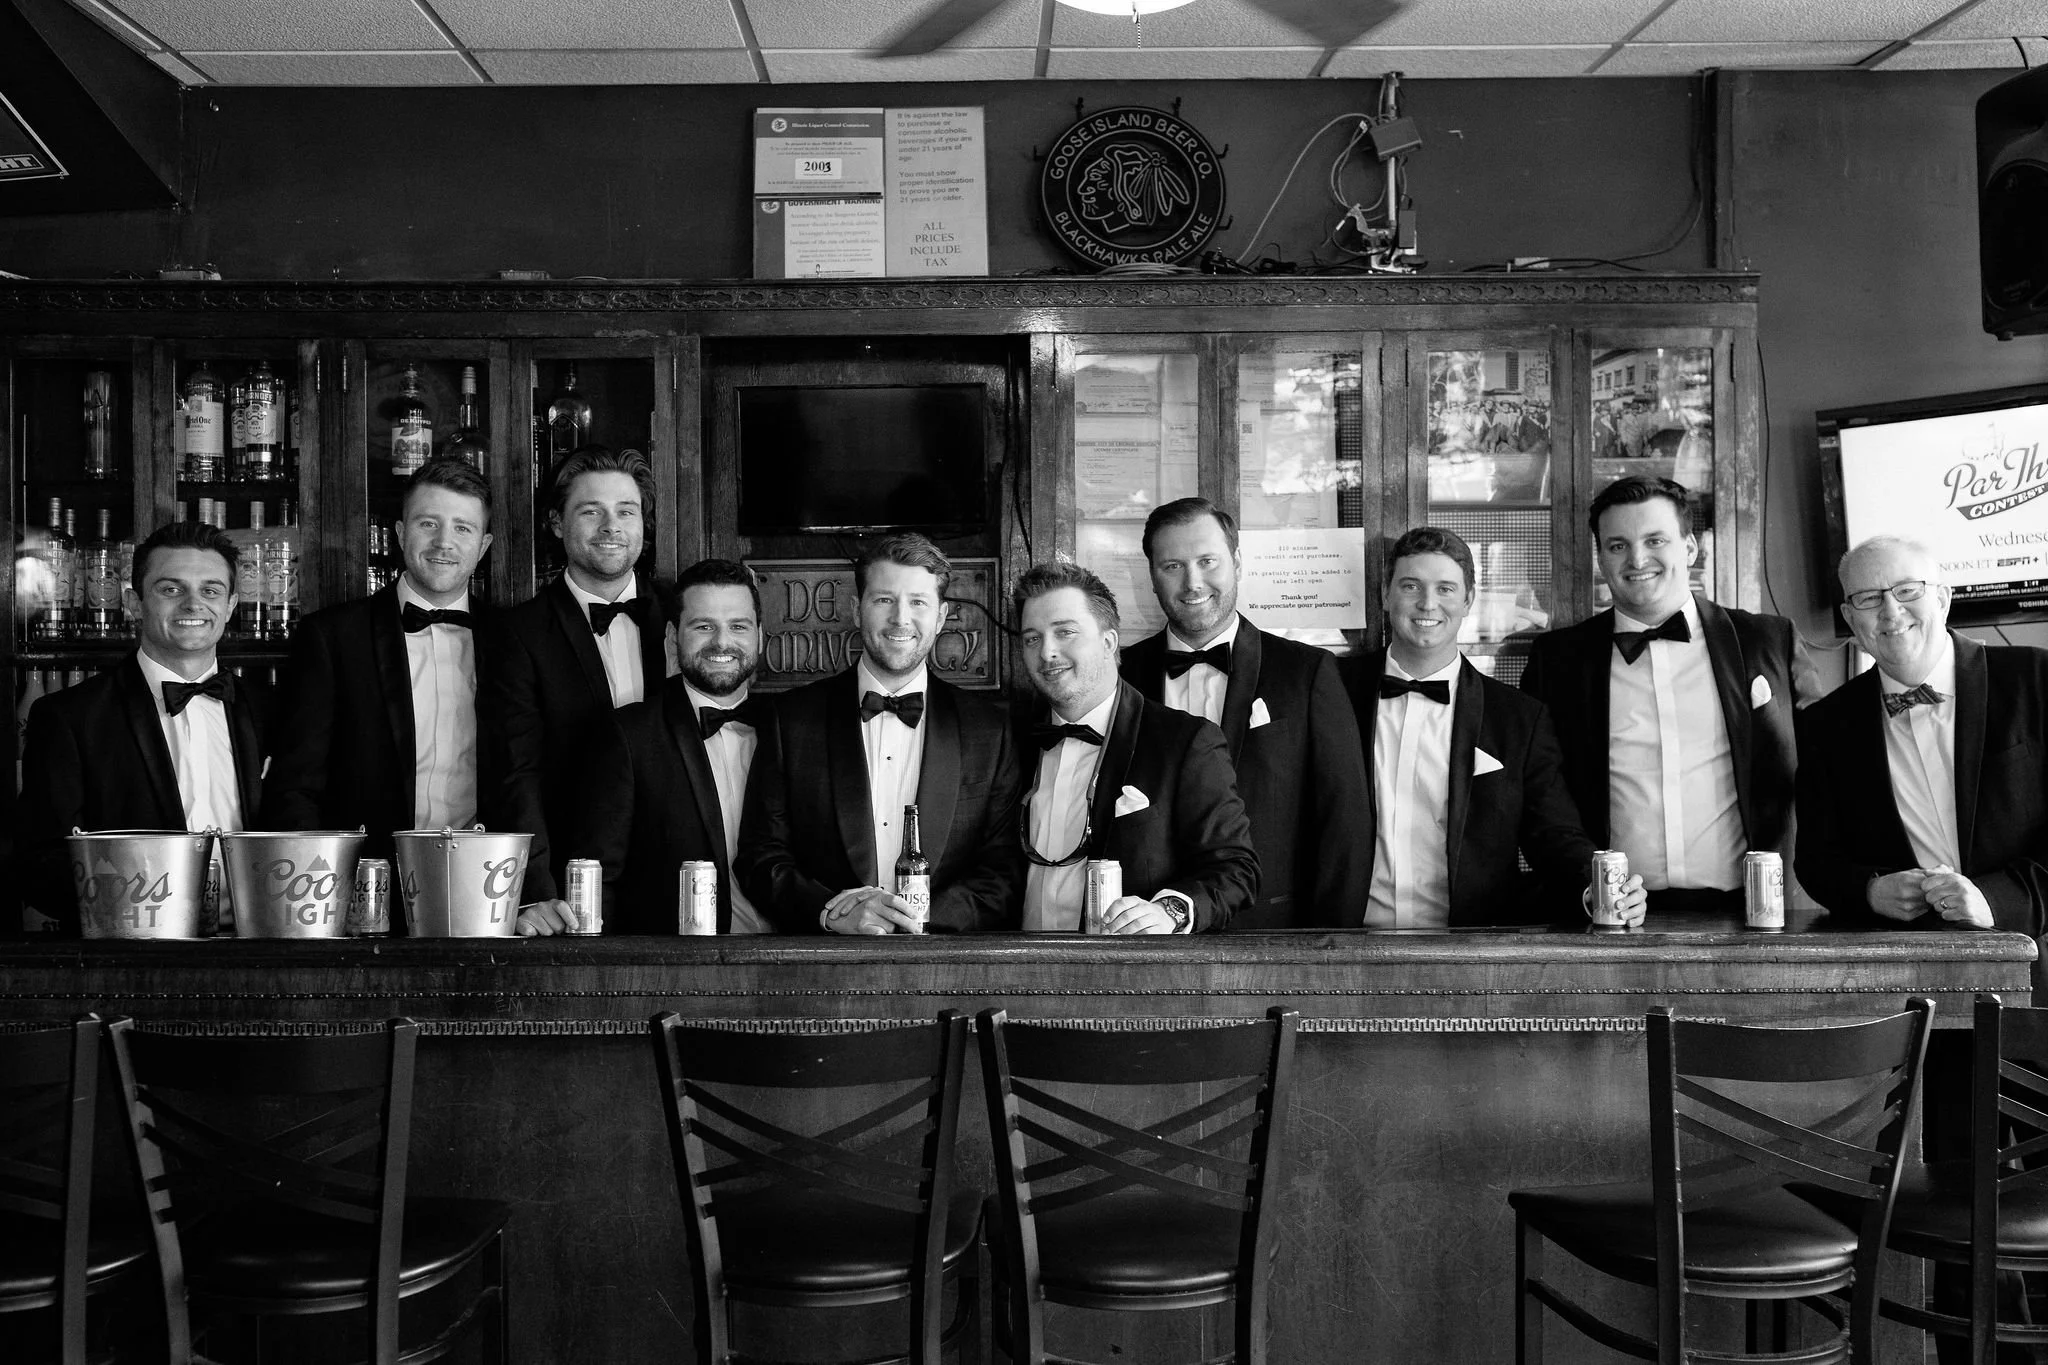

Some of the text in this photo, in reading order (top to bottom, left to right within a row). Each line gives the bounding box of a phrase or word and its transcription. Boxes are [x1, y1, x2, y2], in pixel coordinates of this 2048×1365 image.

[1050, 113, 1212, 179] GOOSE ISLAND BEER CO.
[915, 233, 954, 243] PRICES
[923, 222, 944, 231] ALL
[1055, 211, 1212, 265] BLACKHAWKS PALE ALE
[909, 245, 961, 255] INCLUDE
[924, 258, 948, 267] TAX
[1944, 463, 2007, 509] Par
[1969, 484, 2047, 518] CONTEST
[784, 580, 842, 623] DE
